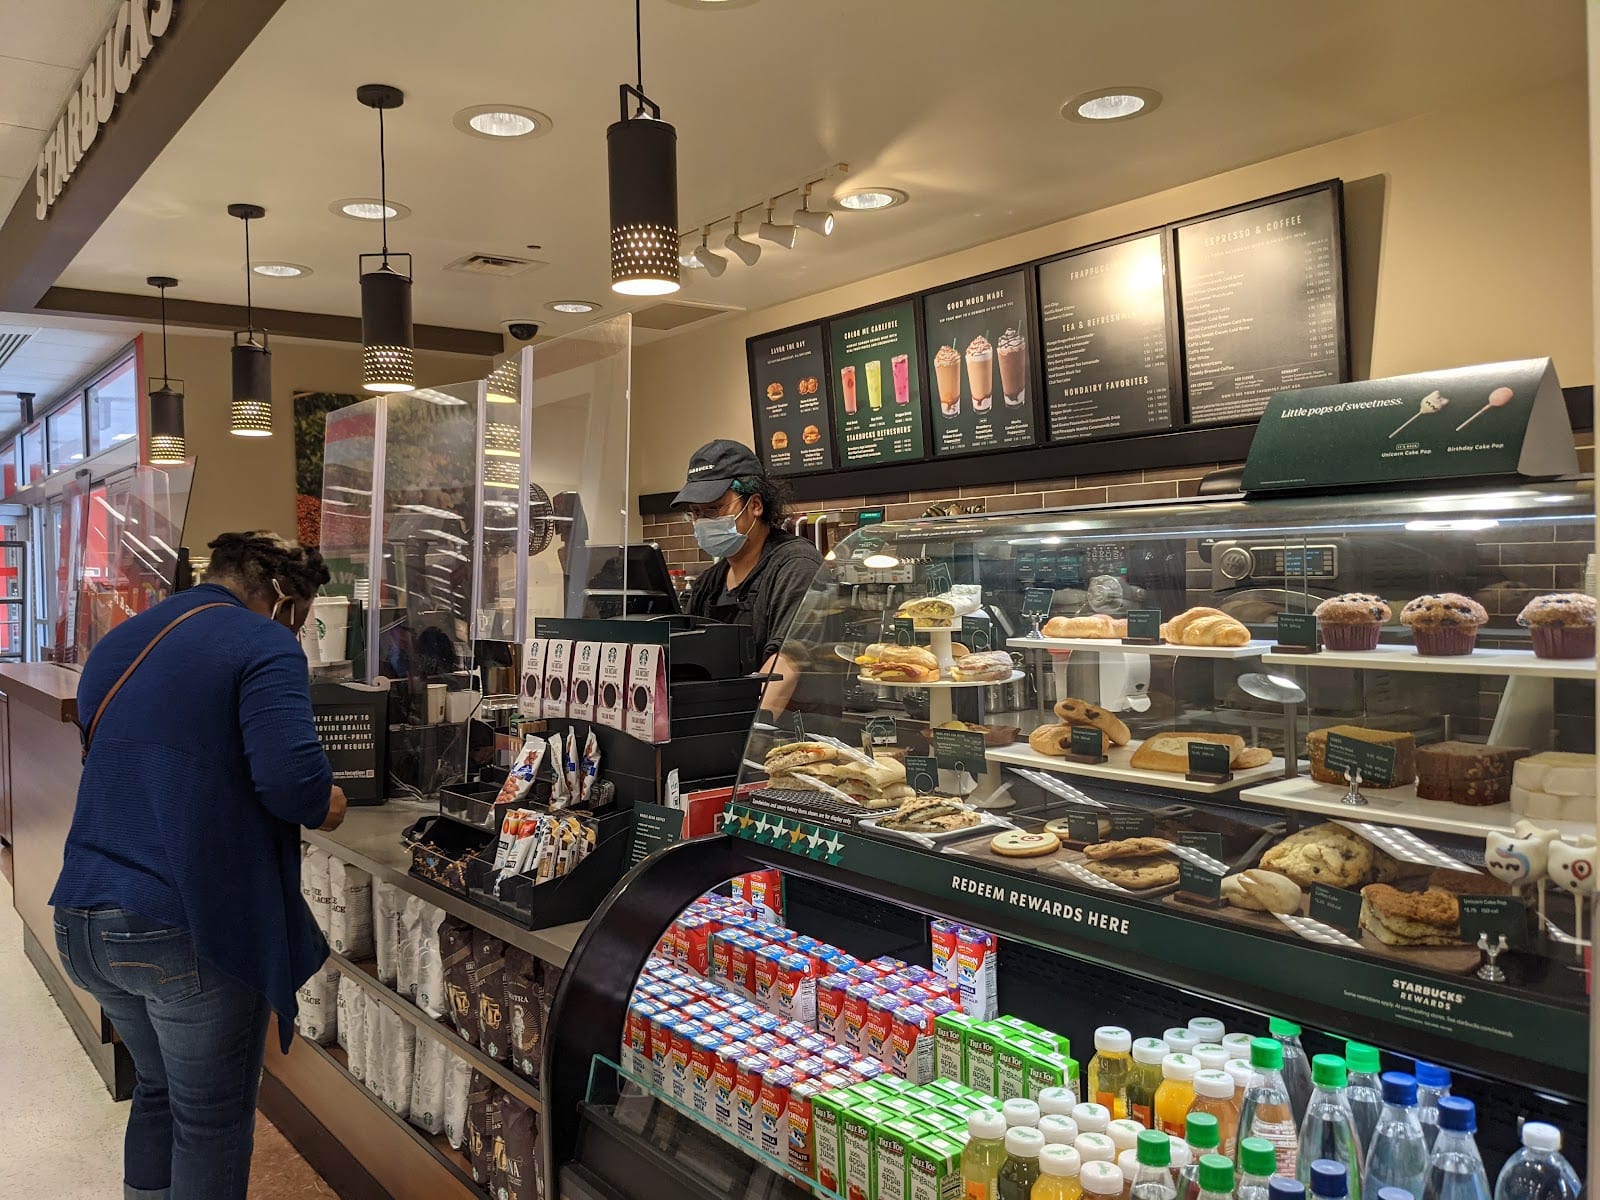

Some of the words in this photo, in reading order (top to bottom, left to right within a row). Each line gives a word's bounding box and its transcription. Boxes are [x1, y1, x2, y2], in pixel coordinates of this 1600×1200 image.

[36, 0, 172, 220] STARBUCKS
[1205, 228, 1250, 248] ESPRESSO
[1256, 226, 1261, 234] &
[1266, 215, 1302, 232] COFFEE
[1070, 263, 1114, 280] FRAPPUCC
[946, 300, 964, 310] GOOD
[966, 296, 984, 306] MOOD
[986, 290, 1004, 301] MADE
[844, 329, 860, 340] COLOR
[861, 328, 869, 336] ME
[870, 320, 898, 332] CAREFREE
[1062, 323, 1075, 332] TEA
[786, 343, 795, 351] THE
[796, 340, 806, 349] DAY
[1064, 384, 1102, 396] NONDAIRY
[1106, 376, 1148, 390] FAVORITES
[1280, 408, 1307, 418] Little
[1307, 405, 1334, 417] pops
[1334, 402, 1348, 412] of
[1346, 398, 1404, 411] sweetness.
[846, 430, 876, 442] STARBUCKS
[752, 798, 770, 808] Sandwiches
[786, 806, 798, 814] bakery
[830, 814, 842, 824] display
[842, 816, 852, 825] only.
[952, 876, 1005, 902] REDEEM
[1008, 890, 1083, 923] REWARDS
[1088, 910, 1130, 936] HERE
[1392, 979, 1463, 1004] STARBUCKS
[1400, 992, 1451, 1010] REWARDS
[1381, 1000, 1394, 1008] apply.
[1400, 1004, 1430, 1018] participating
[1430, 1012, 1446, 1020] stores.
[938, 1029, 950, 1038] TREE
[950, 1030, 960, 1039] TOP
[938, 1043, 961, 1056] organic
[970, 1040, 982, 1048] TREE
[982, 1042, 994, 1050] TOP
[940, 1060, 958, 1070] apple
[970, 1053, 994, 1068] organic
[1000, 1053, 1012, 1062] TREE
[1012, 1056, 1022, 1065] TOP
[941, 1066, 958, 1078] juice
[972, 1072, 990, 1083] apple
[999, 1068, 1022, 1082] organic
[1030, 1068, 1042, 1078] TREE
[1042, 1072, 1054, 1081] TOP
[973, 1079, 990, 1090] juice
[1002, 1087, 1020, 1098] apple
[816, 1108, 826, 1118] TREE
[826, 1111, 836, 1121] TOP
[816, 1120, 838, 1138] organic
[845, 1122, 858, 1132] TREE
[857, 1126, 868, 1136] TOP
[819, 1140, 834, 1154] apple
[846, 1134, 869, 1154] organic
[879, 1137, 892, 1148] TREE
[892, 1141, 904, 1152] TOP
[820, 1150, 835, 1162] juice
[848, 1156, 866, 1170] apple
[878, 1151, 904, 1170] organic
[912, 1156, 924, 1166] TREE
[924, 1160, 936, 1172] TOP
[850, 1166, 866, 1178] juice
[882, 1173, 900, 1186] apple
[912, 1171, 938, 1191] organic
[882, 1182, 900, 1196] juice
